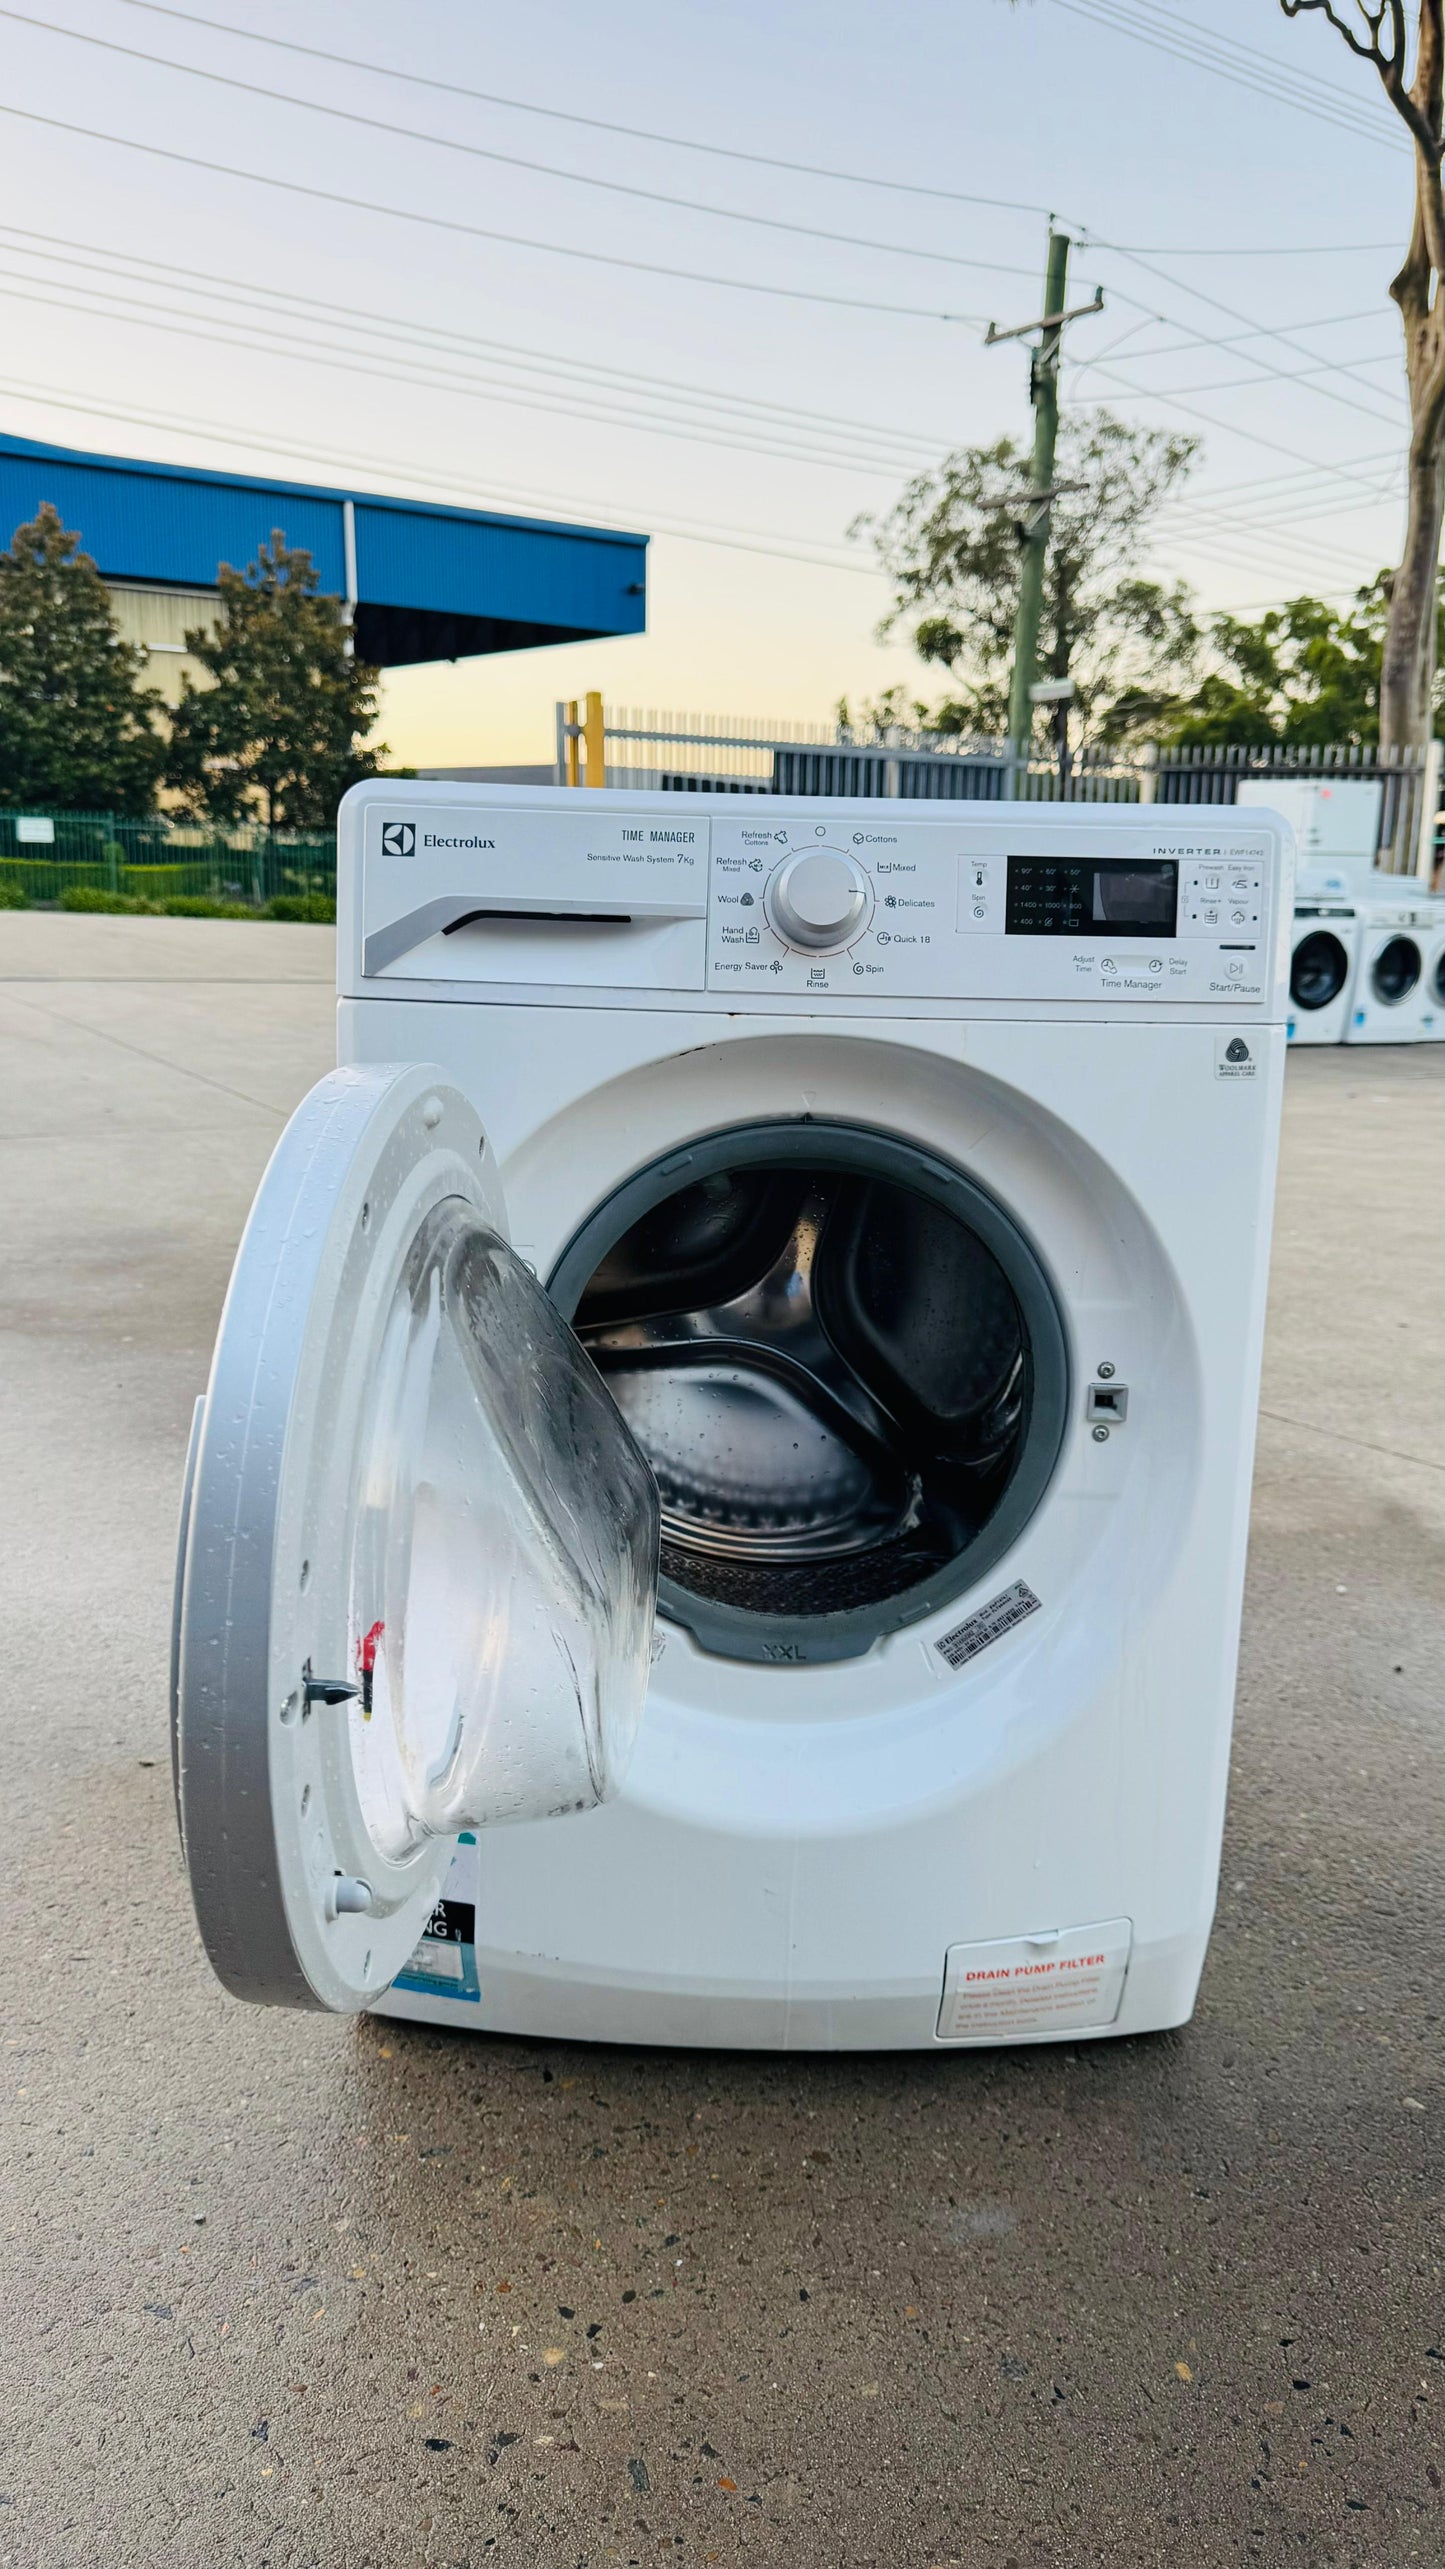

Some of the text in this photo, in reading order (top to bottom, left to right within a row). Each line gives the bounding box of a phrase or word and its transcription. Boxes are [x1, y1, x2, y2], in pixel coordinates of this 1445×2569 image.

[622, 829, 695, 843] TIME MANAGER
[741, 830, 772, 839] Refresh
[865, 834, 898, 843] Cottons
[424, 834, 496, 849] Electrolux
[587, 853, 621, 861] Sensitive
[623, 854, 645, 863] Wash
[646, 855, 675, 864] System
[716, 857, 747, 866] Refresh
[892, 863, 917, 872] Mixed
[717, 895, 739, 904] Wool
[897, 898, 936, 908] Delicates
[722, 926, 744, 935] Hand
[721, 936, 745, 944] Wash
[893, 934, 931, 944] Quick 18
[1072, 954, 1095, 964] Adjust
[714, 962, 768, 972] Energy Saver
[865, 964, 885, 975] Spin
[1075, 965, 1093, 973] Time
[806, 979, 829, 989] Rinse
[1100, 978, 1163, 991] Time Manager
[1208, 982, 1261, 994] Start/Pause
[944, 1618, 979, 1645] Electrolux
[761, 1643, 807, 1660] XXL
[965, 1954, 1105, 1982] DRAIN PUMP FILTER
